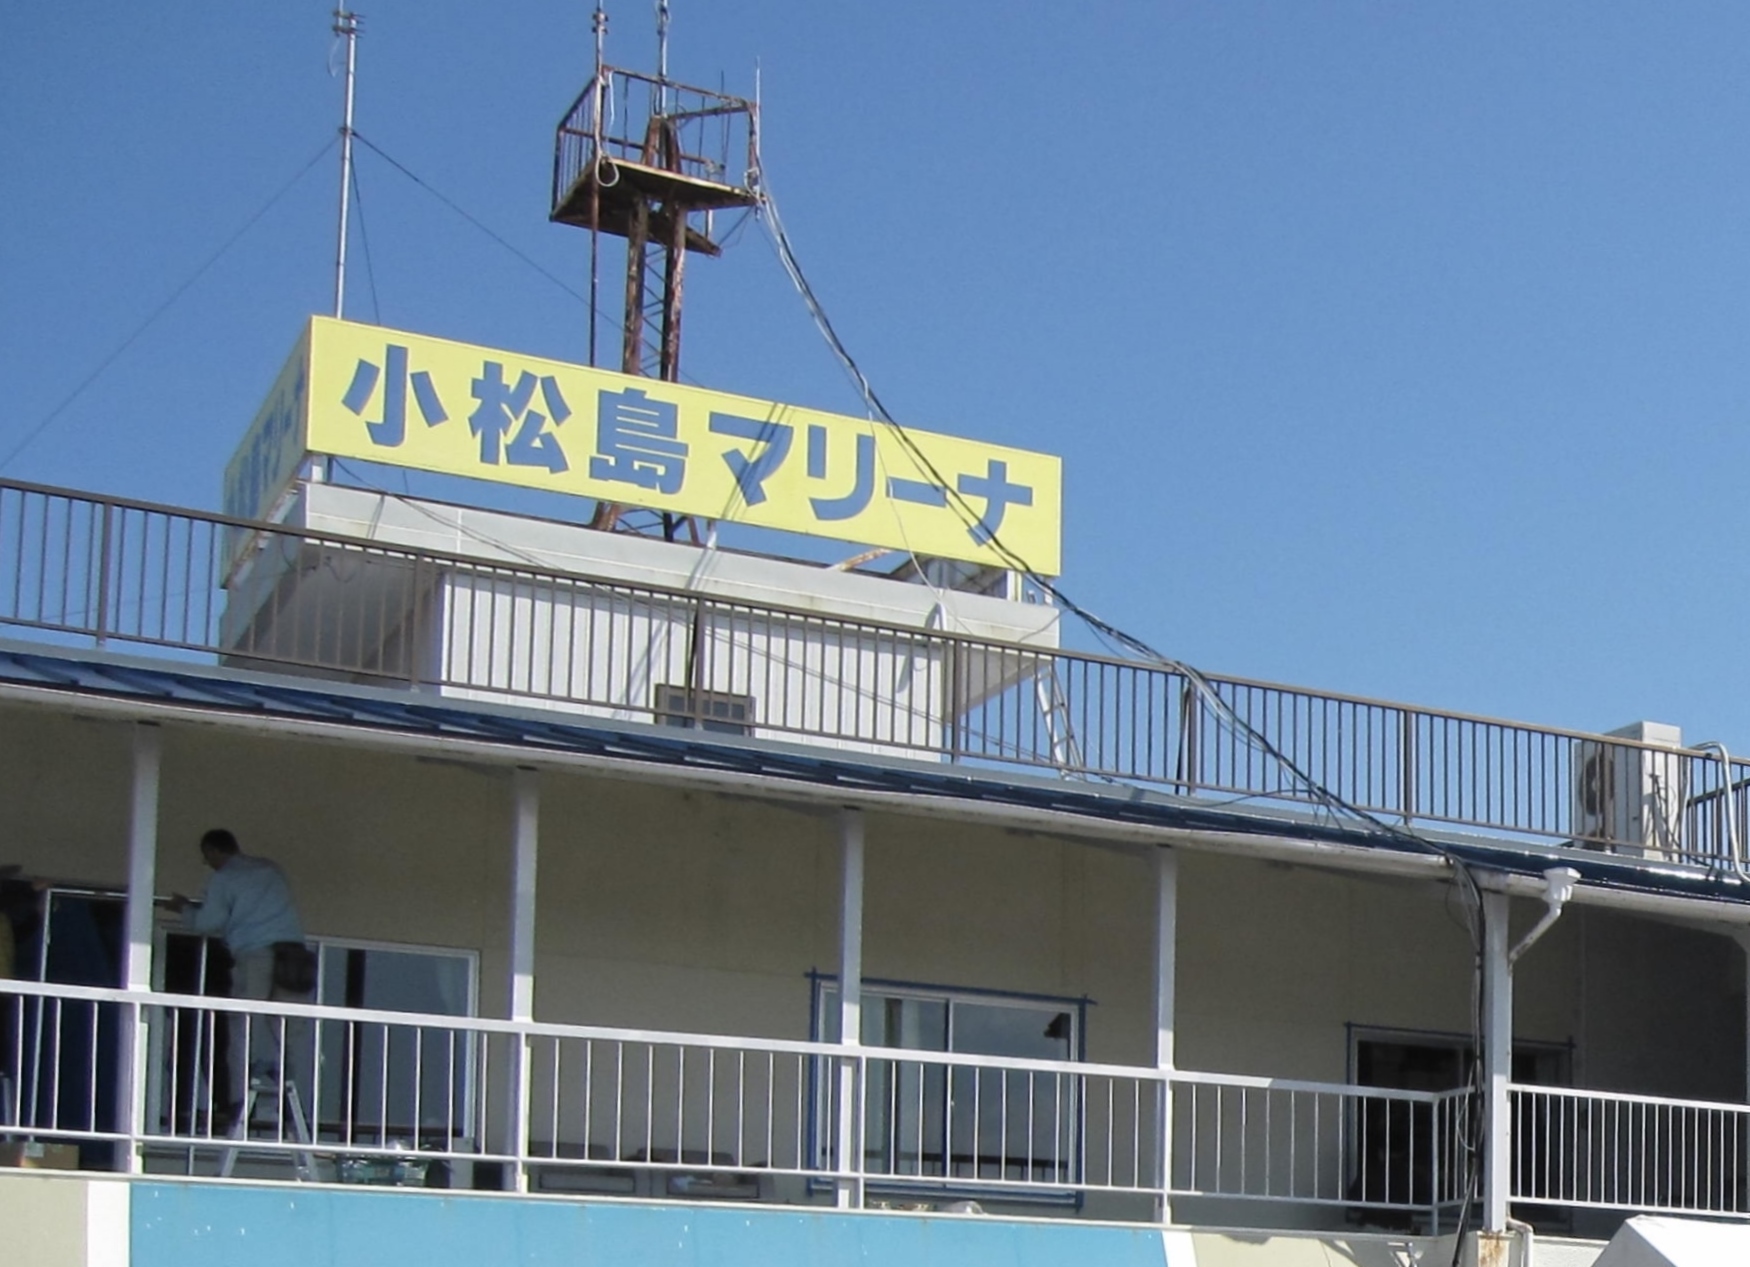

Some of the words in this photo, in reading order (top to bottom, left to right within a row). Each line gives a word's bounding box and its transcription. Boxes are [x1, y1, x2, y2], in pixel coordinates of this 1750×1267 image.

[342, 344, 1034, 547] 小松島マリーナ
